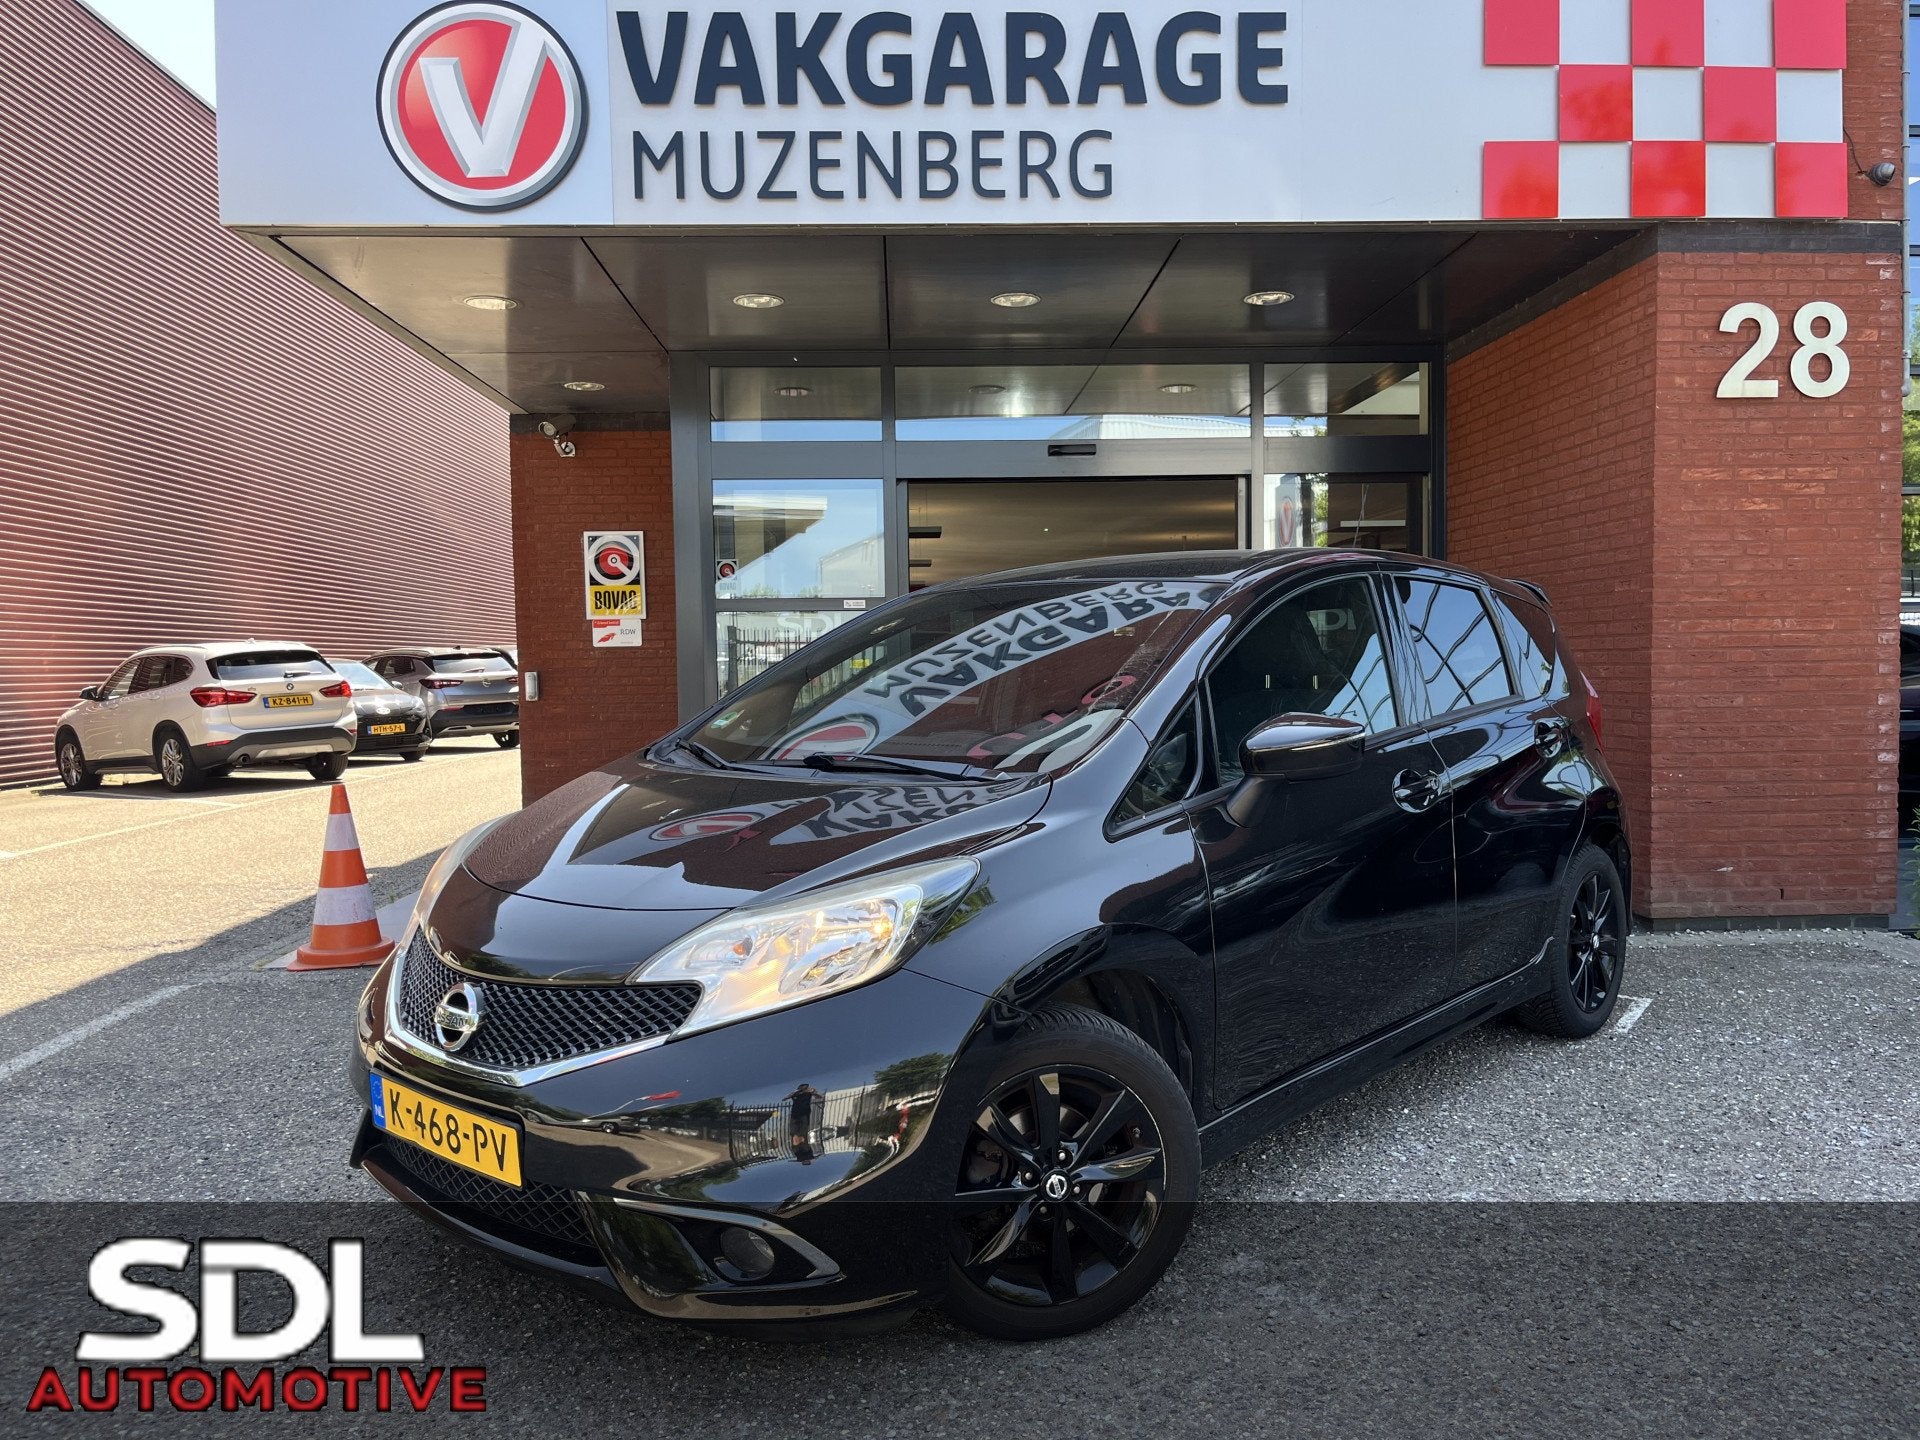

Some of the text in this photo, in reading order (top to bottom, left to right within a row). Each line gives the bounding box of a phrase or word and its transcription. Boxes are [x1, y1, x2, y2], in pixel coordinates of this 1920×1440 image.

[616, 11, 1288, 105] VAKGARAGE
[633, 129, 1112, 200] MUZENBERG
[1716, 301, 1850, 398] 28
[594, 590, 638, 610] BOVAG
[272, 697, 309, 706] KZ-841-H
[374, 1104, 385, 1119] NL
[389, 1088, 507, 1172] K-468-PV
